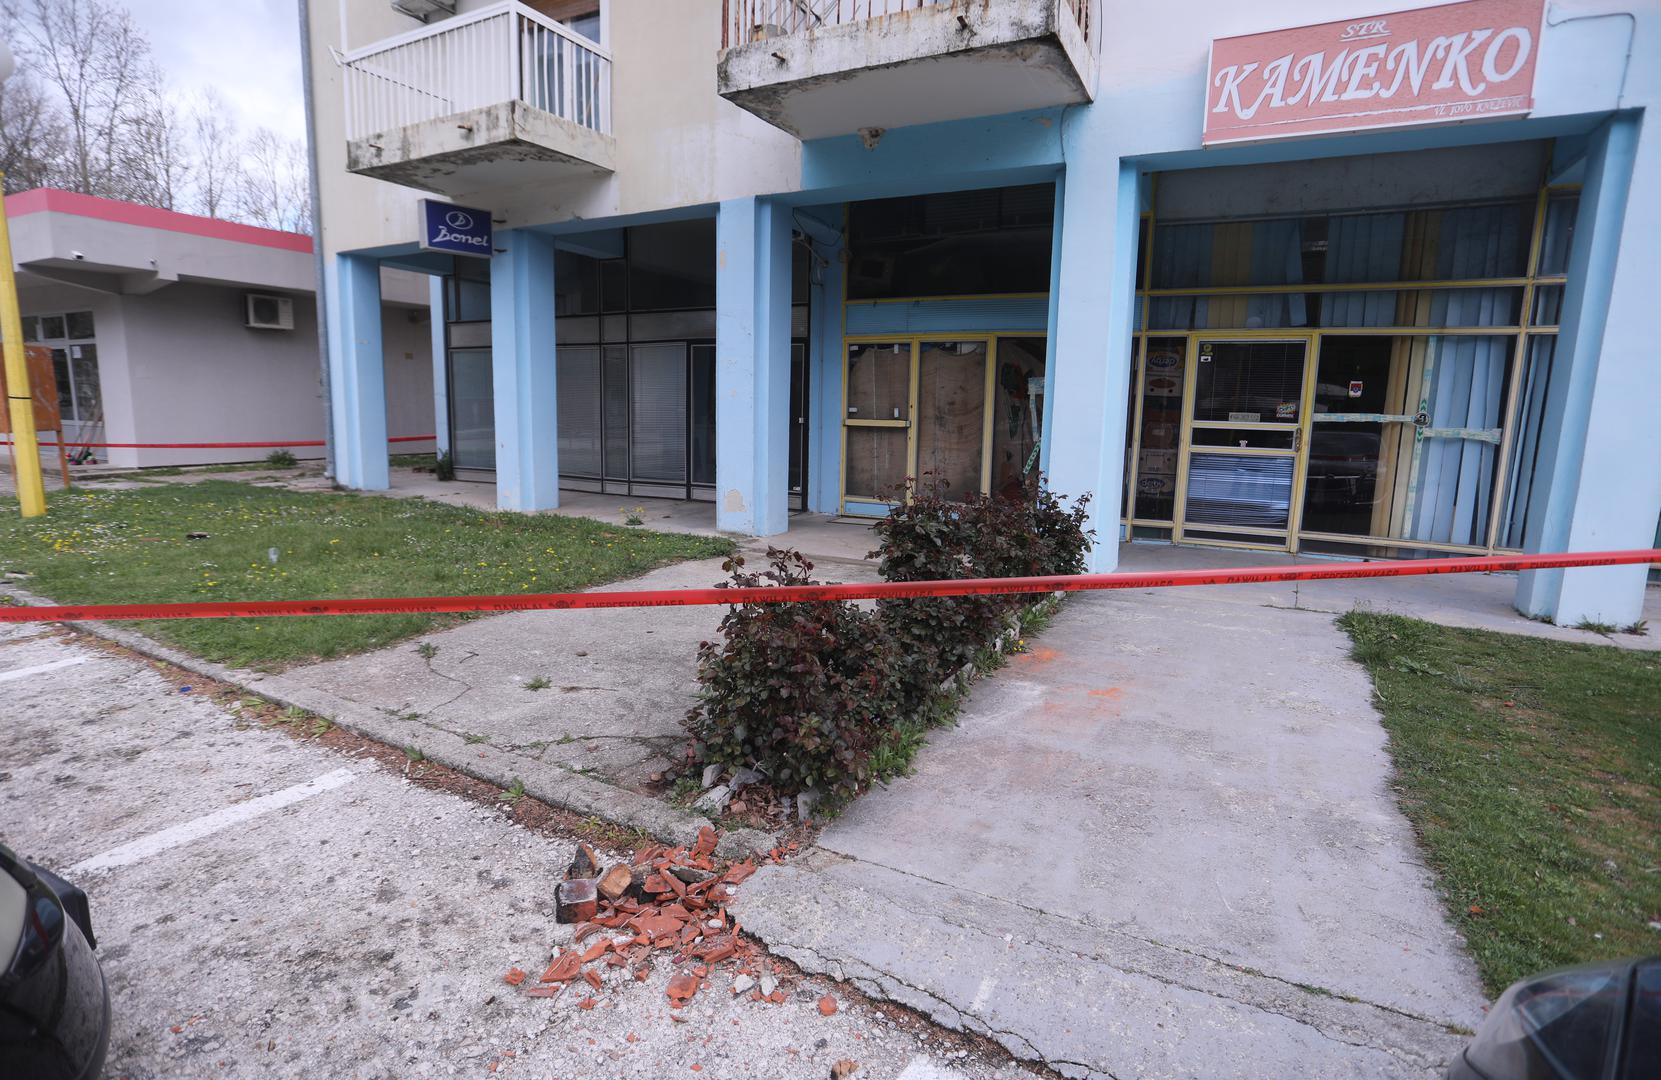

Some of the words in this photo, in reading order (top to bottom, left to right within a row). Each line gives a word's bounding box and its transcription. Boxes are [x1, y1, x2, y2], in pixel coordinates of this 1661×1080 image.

[1340, 20, 1391, 38] STR
[1213, 26, 1533, 120] KAMENKO
[432, 225, 488, 246] Bonel
